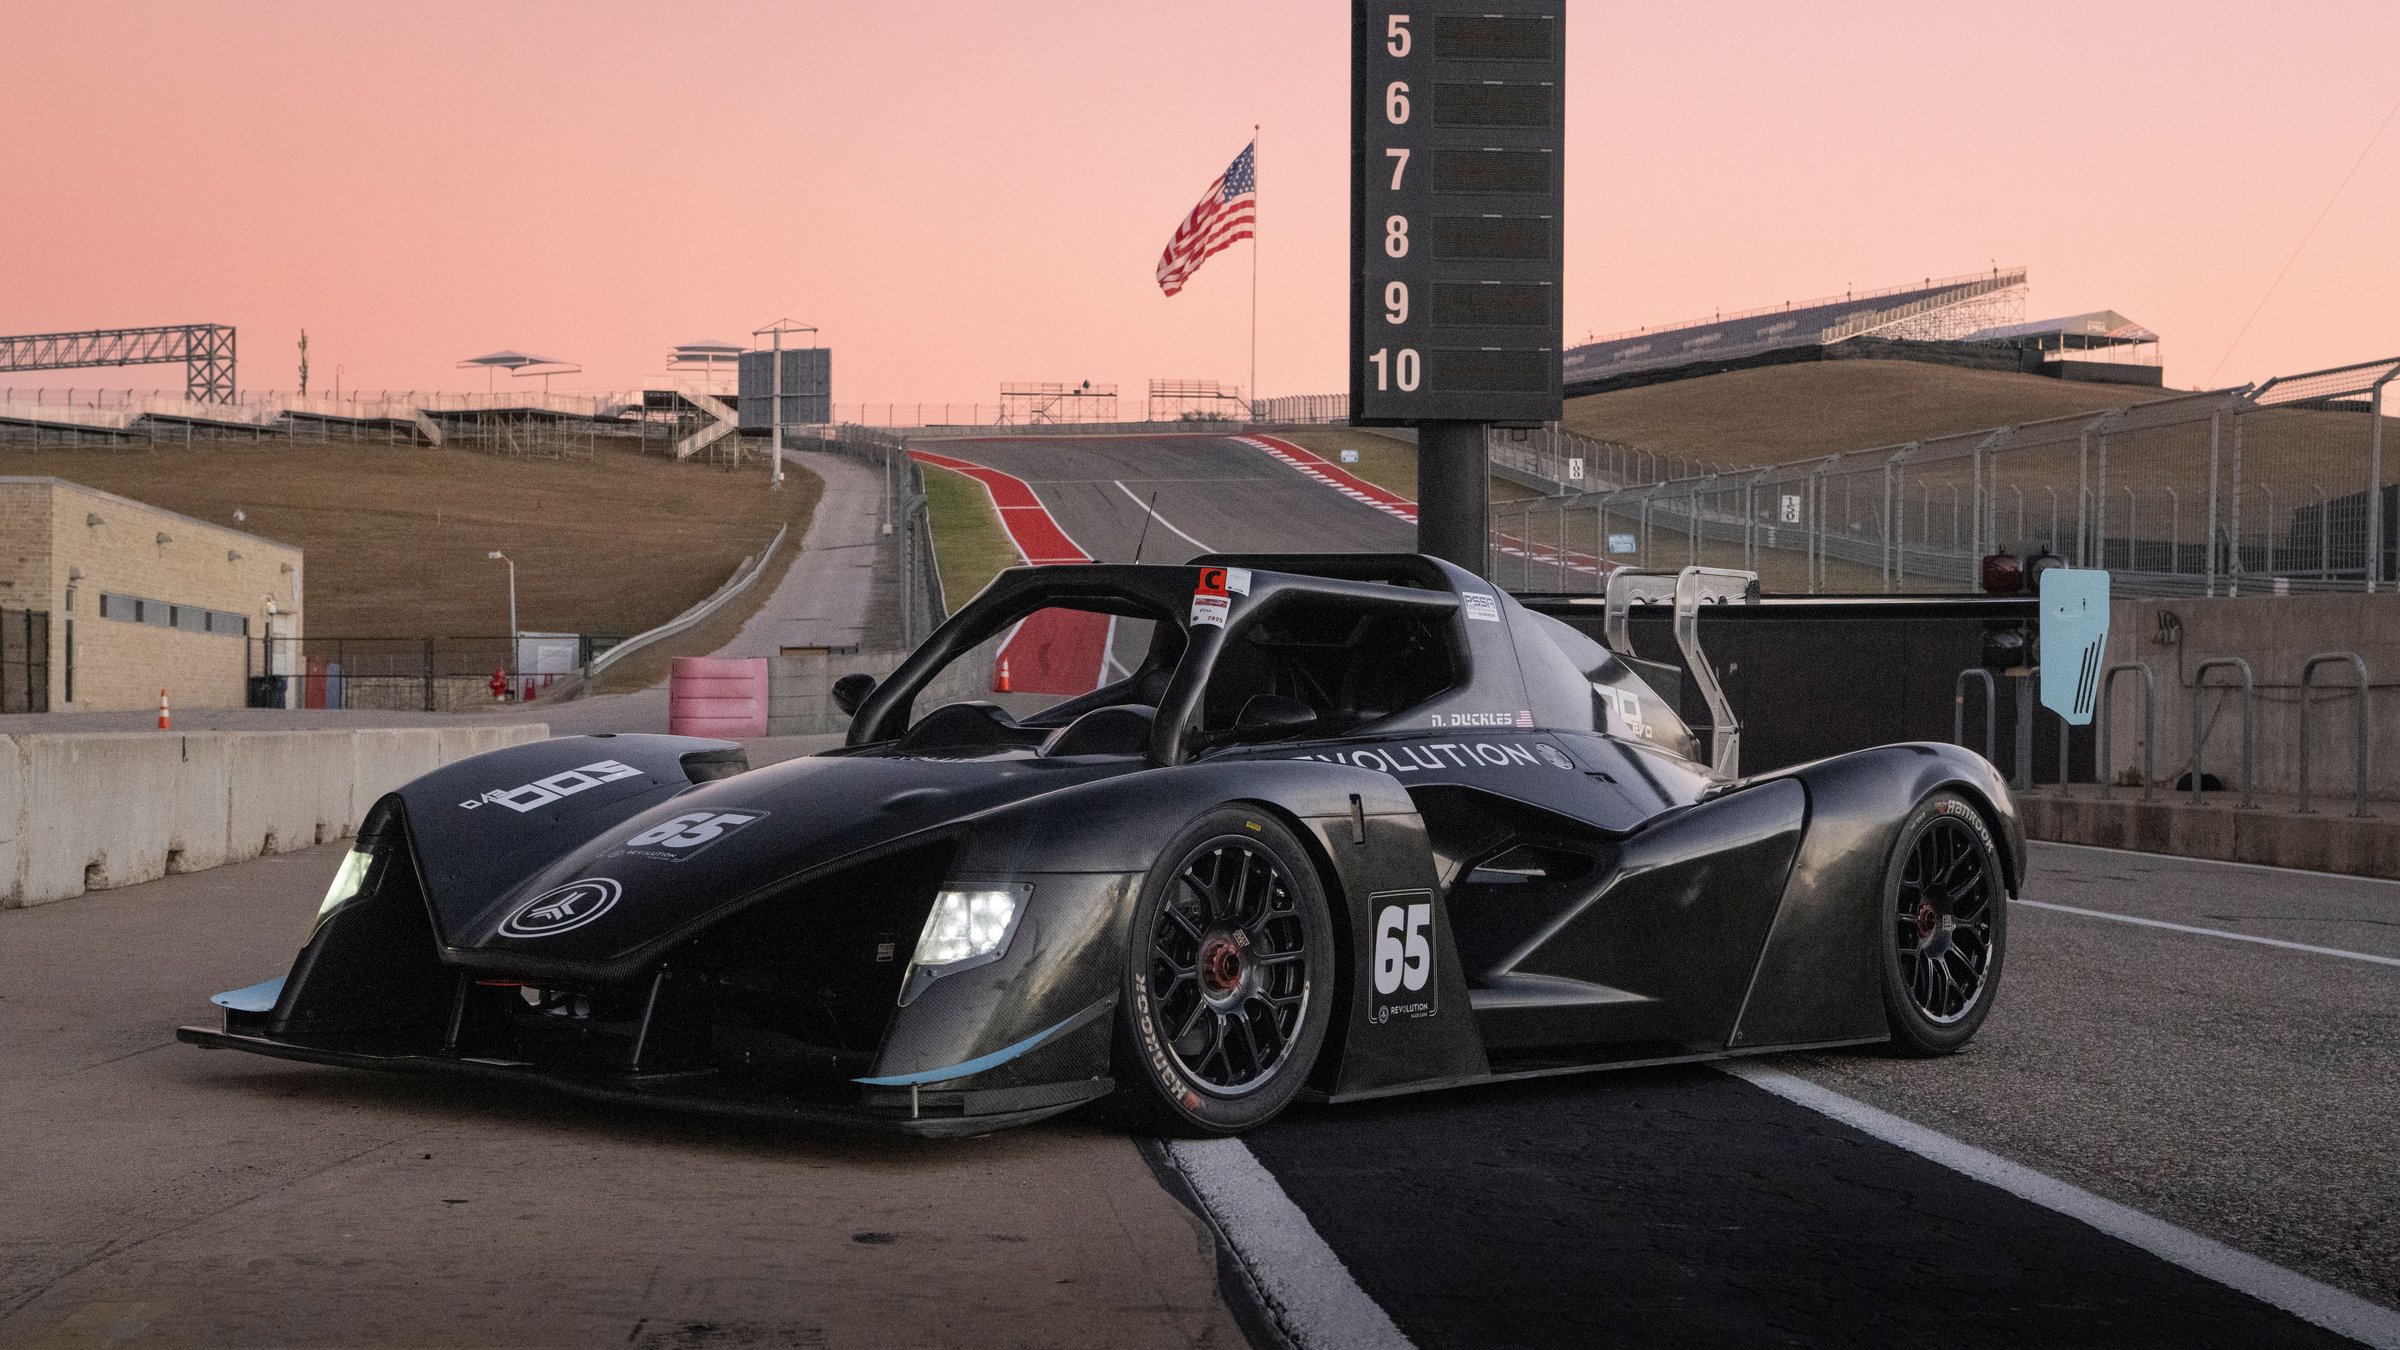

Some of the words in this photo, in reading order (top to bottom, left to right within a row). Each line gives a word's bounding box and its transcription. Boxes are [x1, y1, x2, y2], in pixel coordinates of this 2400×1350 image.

[1386, 14, 1412, 58] 5
[1385, 81, 1410, 125] 6
[1385, 148, 1411, 191] 7
[1384, 214, 1409, 259] 8
[1384, 281, 1409, 325] 9
[1369, 347, 1421, 392] 10
[1204, 570, 1222, 590] C
[1451, 712, 1513, 727] DUCKLES
[626, 812, 757, 848] 65
[1374, 903, 1431, 995] 65
[1390, 1003, 1429, 1014] REVOLUTION
